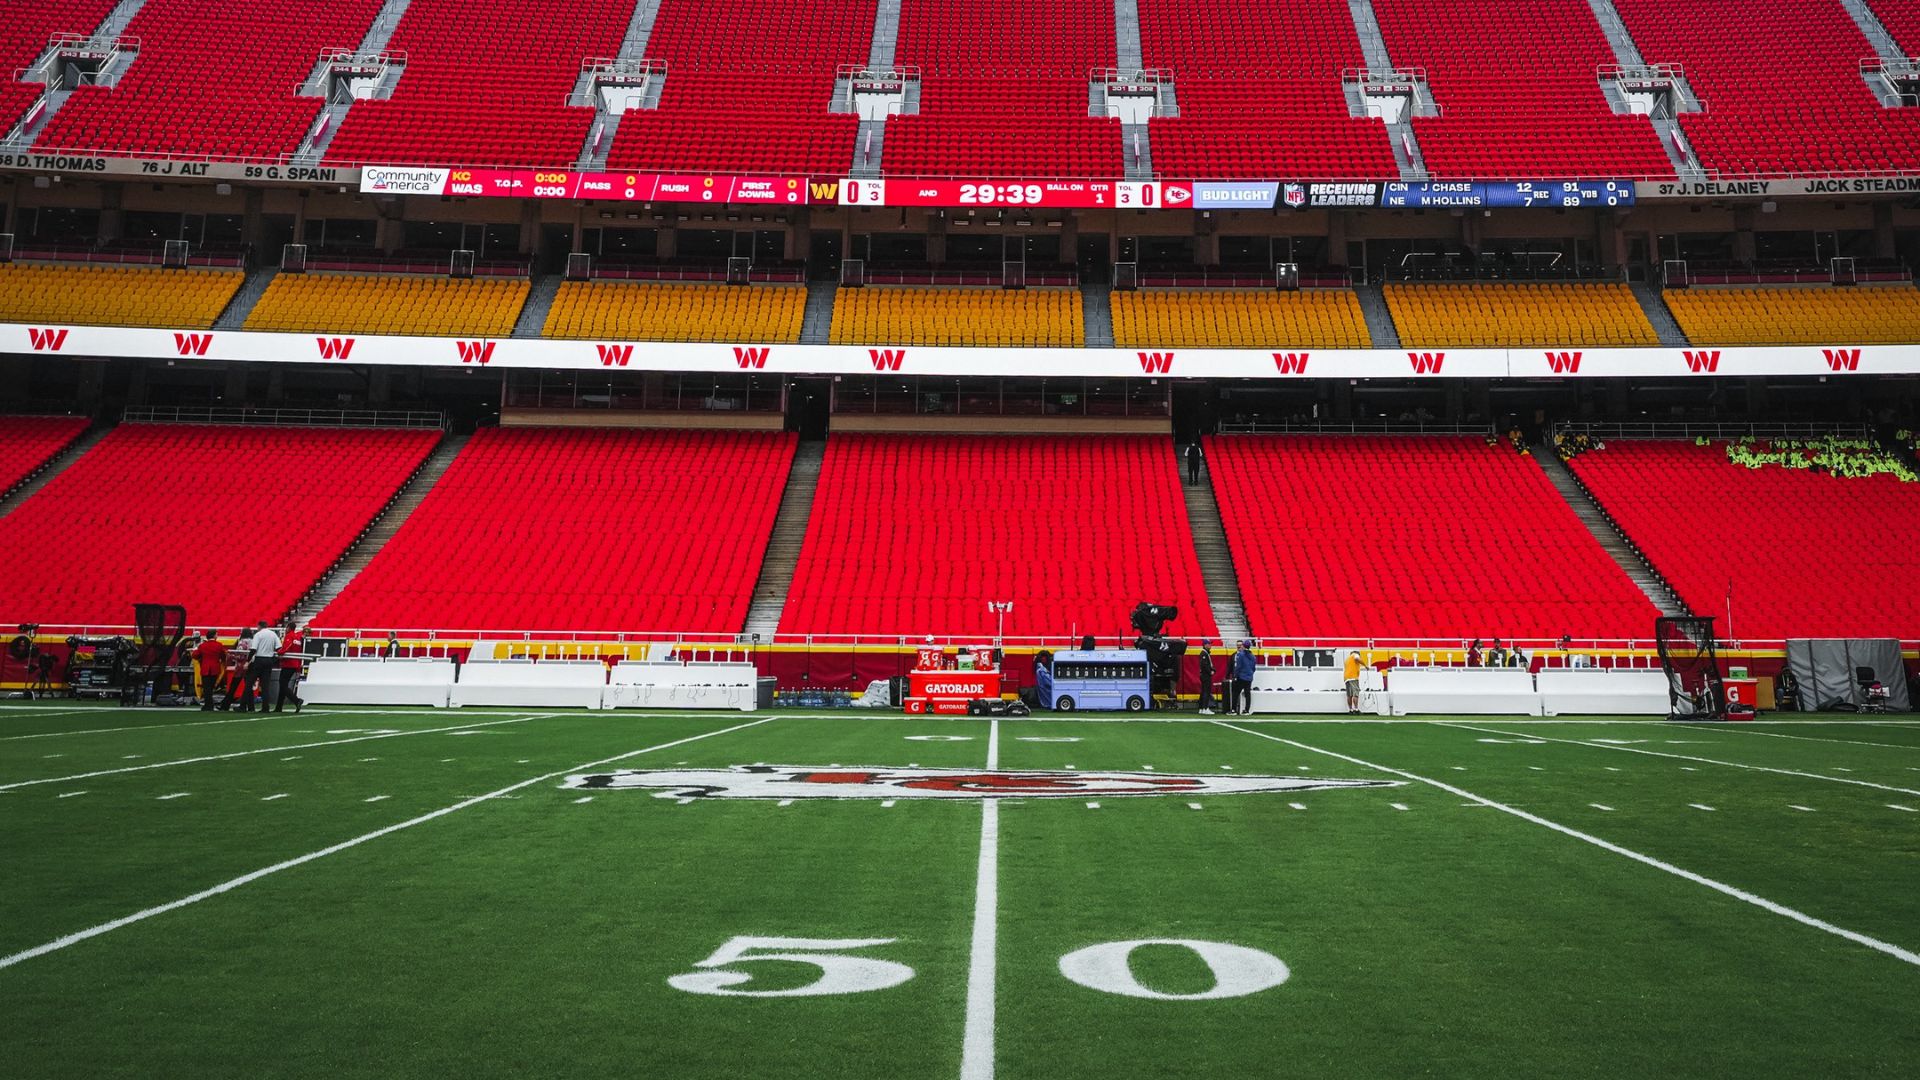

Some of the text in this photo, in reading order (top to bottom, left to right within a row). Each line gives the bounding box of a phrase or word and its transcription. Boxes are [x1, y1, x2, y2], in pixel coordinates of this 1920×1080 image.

[34, 156, 106, 171] THOMAS
[142, 162, 157, 173] 76
[179, 163, 209, 176] ALT
[244, 166, 336, 181] 59 G. SPANI
[367, 169, 441, 184] Community
[452, 171, 471, 181] KC
[535, 173, 567, 184] 0:00
[626, 175, 636, 185] 0
[704, 177, 714, 187] 0
[787, 179, 797, 189] 0
[1804, 178, 1920, 193] JACK STEADM
[452, 184, 483, 194] WAS
[534, 186, 566, 197] 0:00
[584, 182, 611, 190] PASS
[661, 184, 689, 193] RUSH
[742, 182, 772, 190] FIRST
[810, 183, 838, 200] W
[1090, 184, 1108, 192] QTR
[1310, 184, 1376, 195] RECEIVING
[1389, 182, 1532, 192] CIN J CHASE 12
[1563, 182, 1579, 192] 91
[1606, 182, 1616, 192] 0
[1659, 181, 1770, 195] 37 J. DELANEY
[625, 188, 635, 198] 0
[702, 190, 712, 200] 0
[737, 191, 776, 199] DOWNS
[787, 192, 797, 202] 0
[847, 181, 859, 203] 0
[870, 191, 879, 201] 3
[959, 184, 1043, 204] 29:39
[1142, 184, 1153, 206] 0
[1202, 190, 1270, 200] BUD LIGHT
[1533, 190, 1549, 199] REC
[1618, 190, 1629, 198] TD
[1095, 193, 1104, 204] 1
[1121, 194, 1130, 204] 3
[1311, 195, 1375, 206] LEADERS
[1389, 196, 1533, 207] NE M HOLLINS 7
[1563, 196, 1580, 206] 89
[1607, 196, 1617, 206] 0
[29, 329, 68, 350] W
[175, 334, 213, 355] W
[317, 338, 354, 359] W
[457, 342, 496, 363] W
[598, 345, 633, 366] W
[733, 348, 769, 368] W
[869, 350, 905, 370] W
[1822, 350, 1860, 370] W
[1138, 353, 1174, 373] W
[1273, 354, 1309, 374] W
[1408, 353, 1444, 373] W
[1546, 352, 1582, 373] W
[1684, 351, 1720, 372] W
[925, 684, 984, 693] GATORADE
[1727, 686, 1739, 702] G
[911, 702, 919, 711] G
